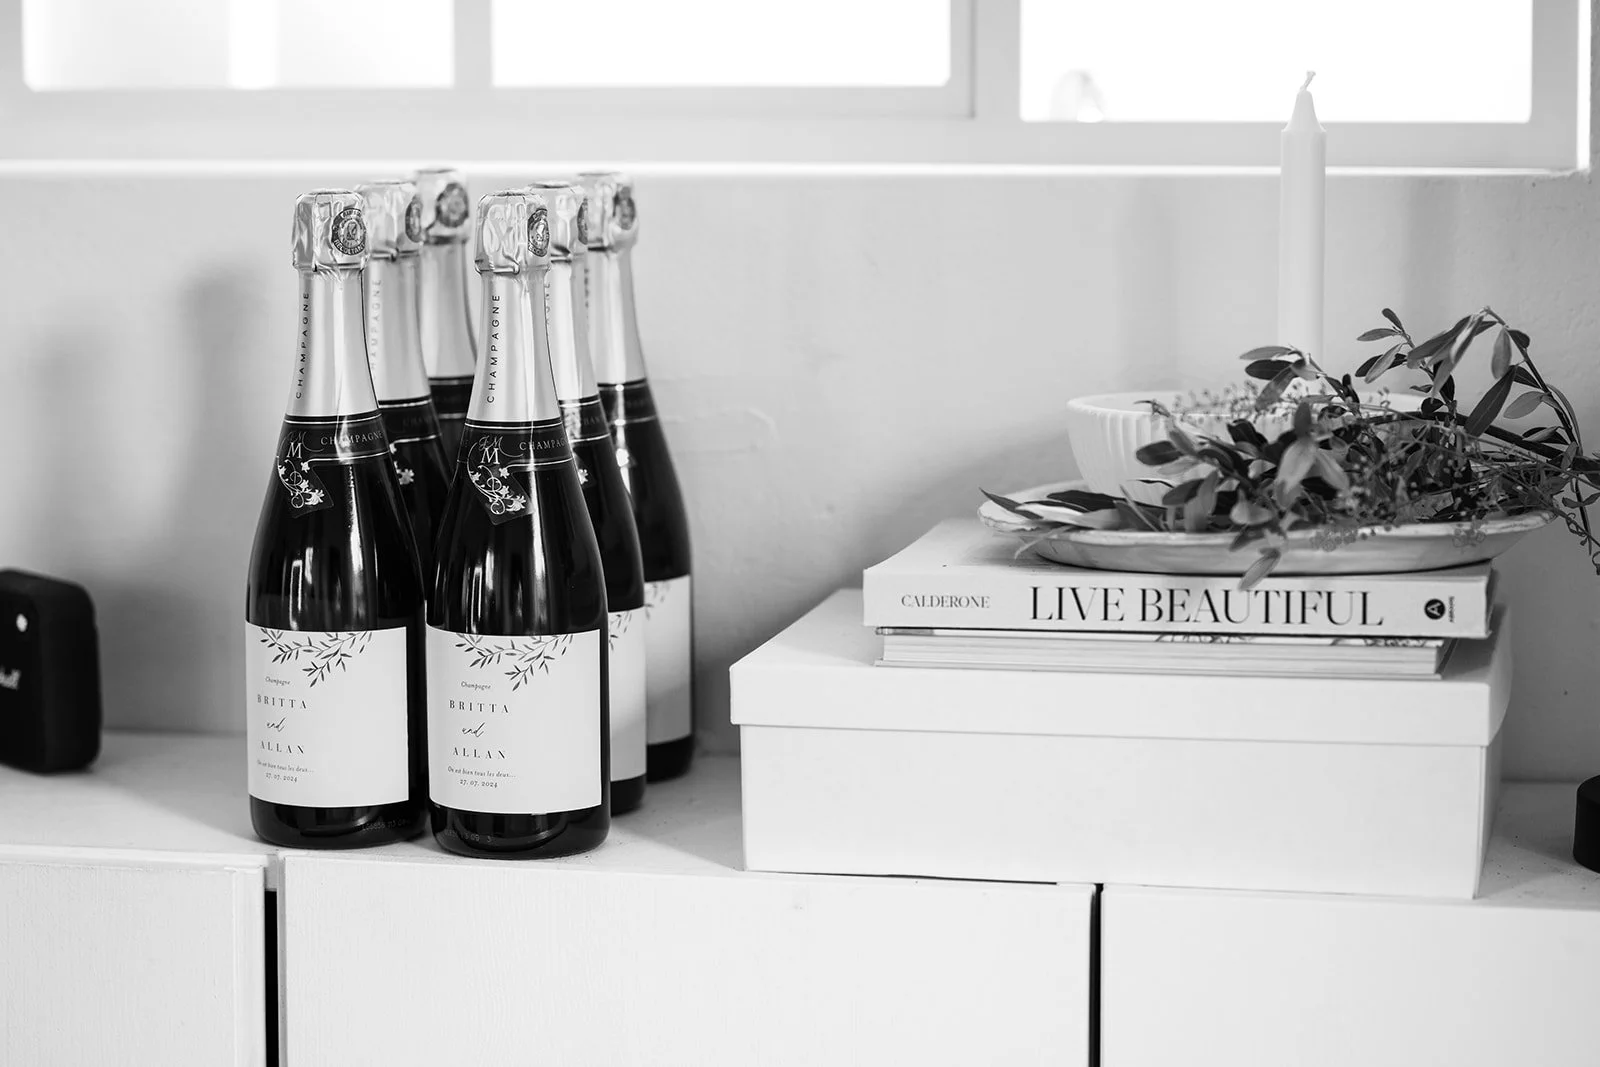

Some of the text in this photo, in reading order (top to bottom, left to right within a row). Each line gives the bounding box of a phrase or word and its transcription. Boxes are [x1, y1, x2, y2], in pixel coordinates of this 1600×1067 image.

[486, 295, 500, 404] CHAMPAGNE
[320, 430, 383, 446] CHMPAGNE
[901, 593, 991, 610] CALDERONE
[1029, 586, 1385, 627] LIVE BEAUTIFUL
[460, 681, 492, 691] Champagne
[257, 693, 307, 709] BRITTA
[449, 699, 509, 714] BRITTA
[261, 740, 305, 754] ALLAN
[452, 747, 506, 760] ALLAN
